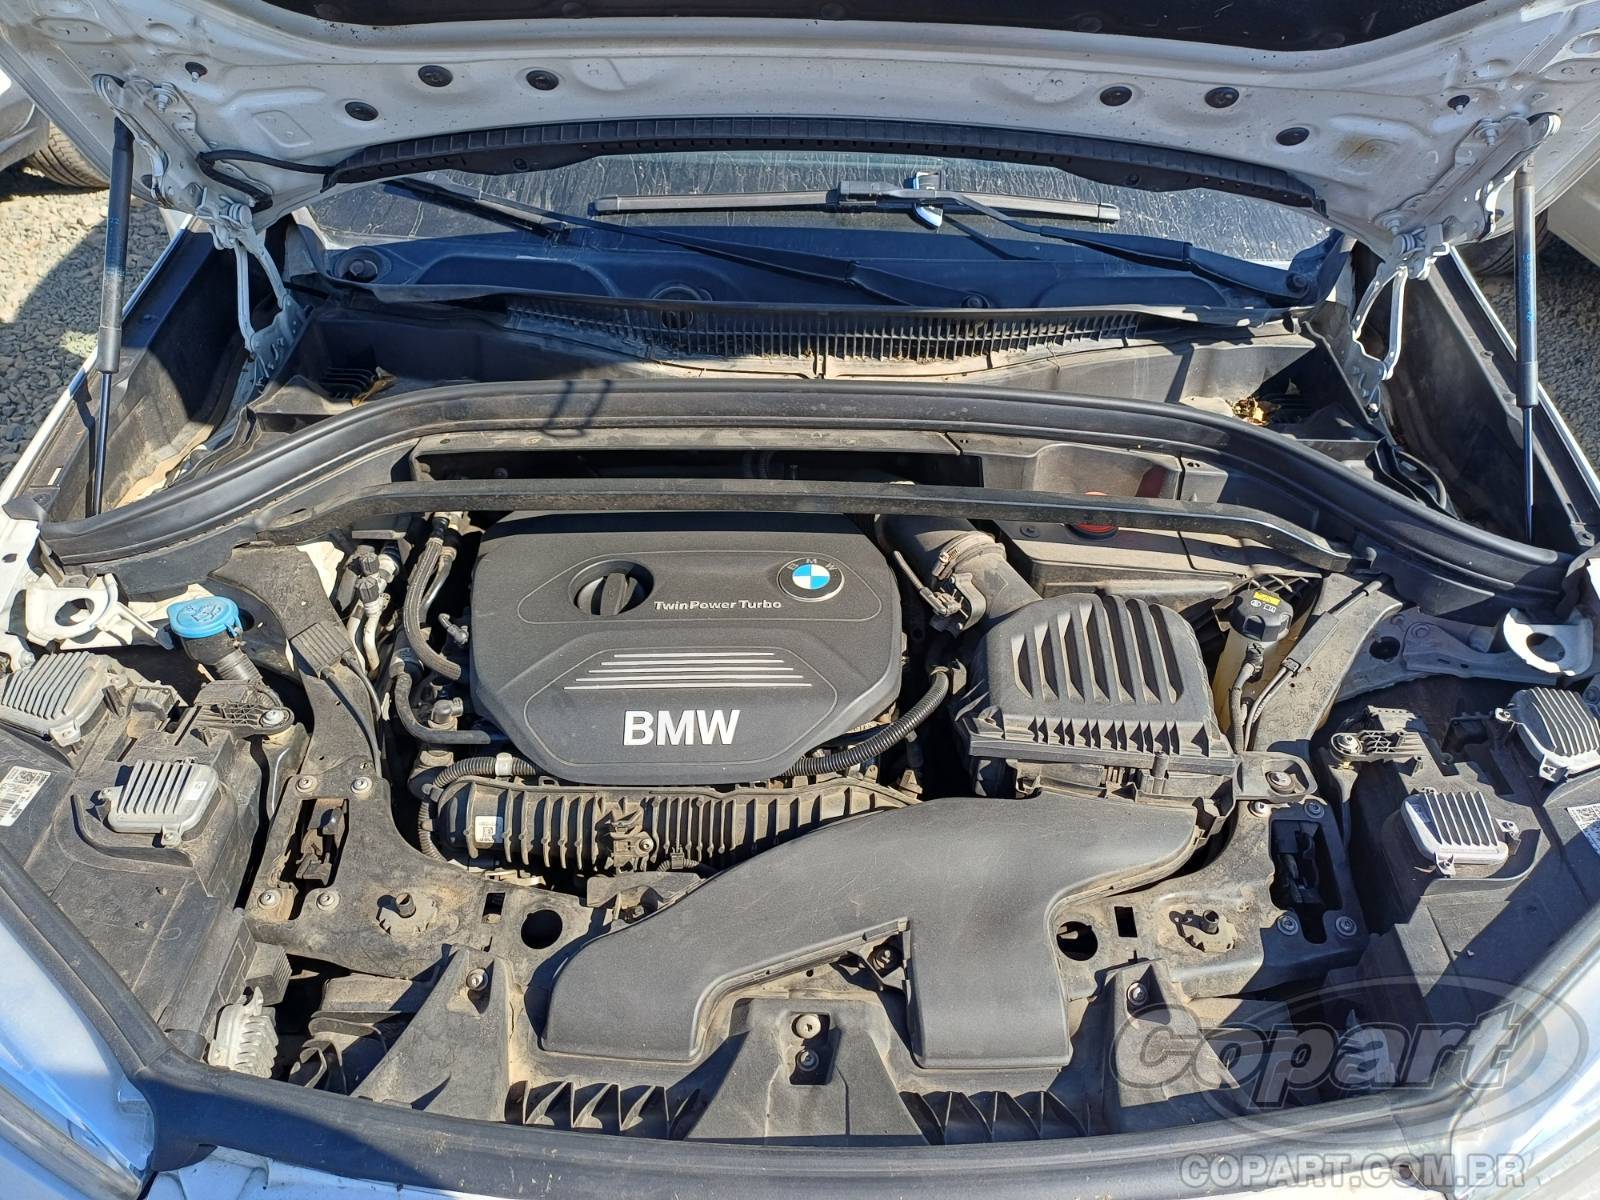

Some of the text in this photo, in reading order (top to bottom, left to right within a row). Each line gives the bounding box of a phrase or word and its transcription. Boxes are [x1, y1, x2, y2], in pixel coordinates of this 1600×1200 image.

[786, 557, 838, 571] BMW
[654, 599, 782, 611] TwinPower Turbo
[623, 709, 741, 746] BMW
